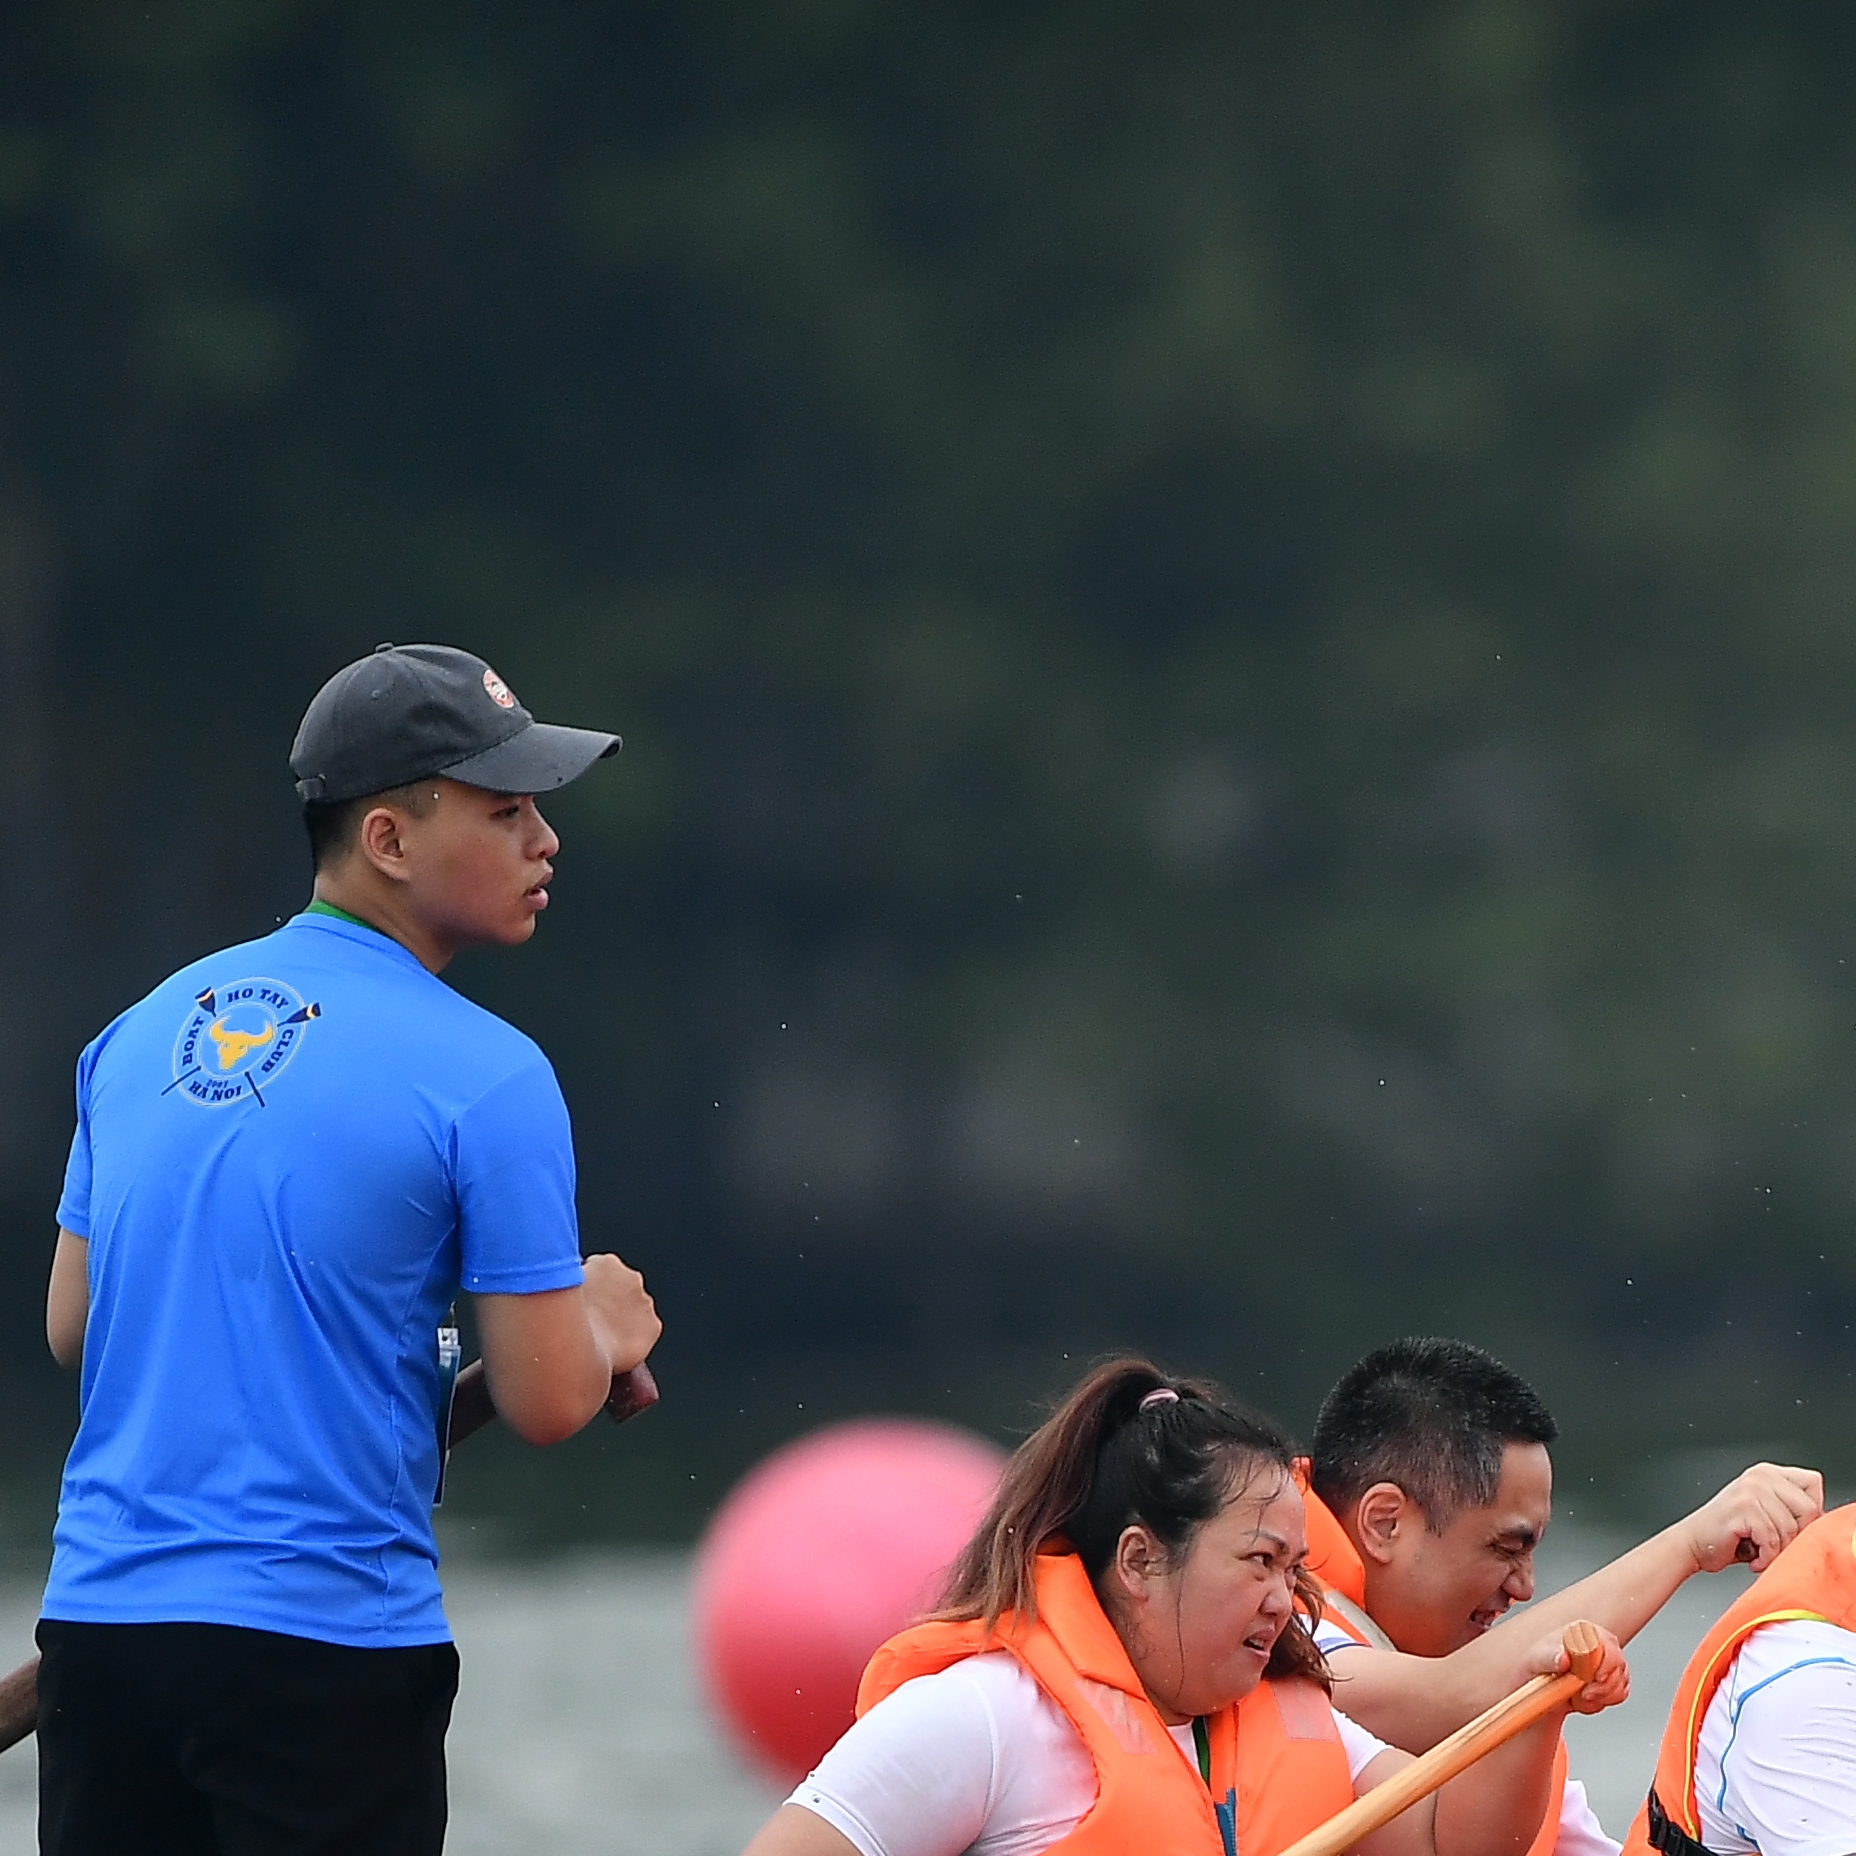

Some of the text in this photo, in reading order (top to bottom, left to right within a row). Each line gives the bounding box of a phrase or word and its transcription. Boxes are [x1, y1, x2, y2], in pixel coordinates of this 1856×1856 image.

[227, 988, 290, 1009] HO TAY
[261, 1030, 294, 1073] CLUB
